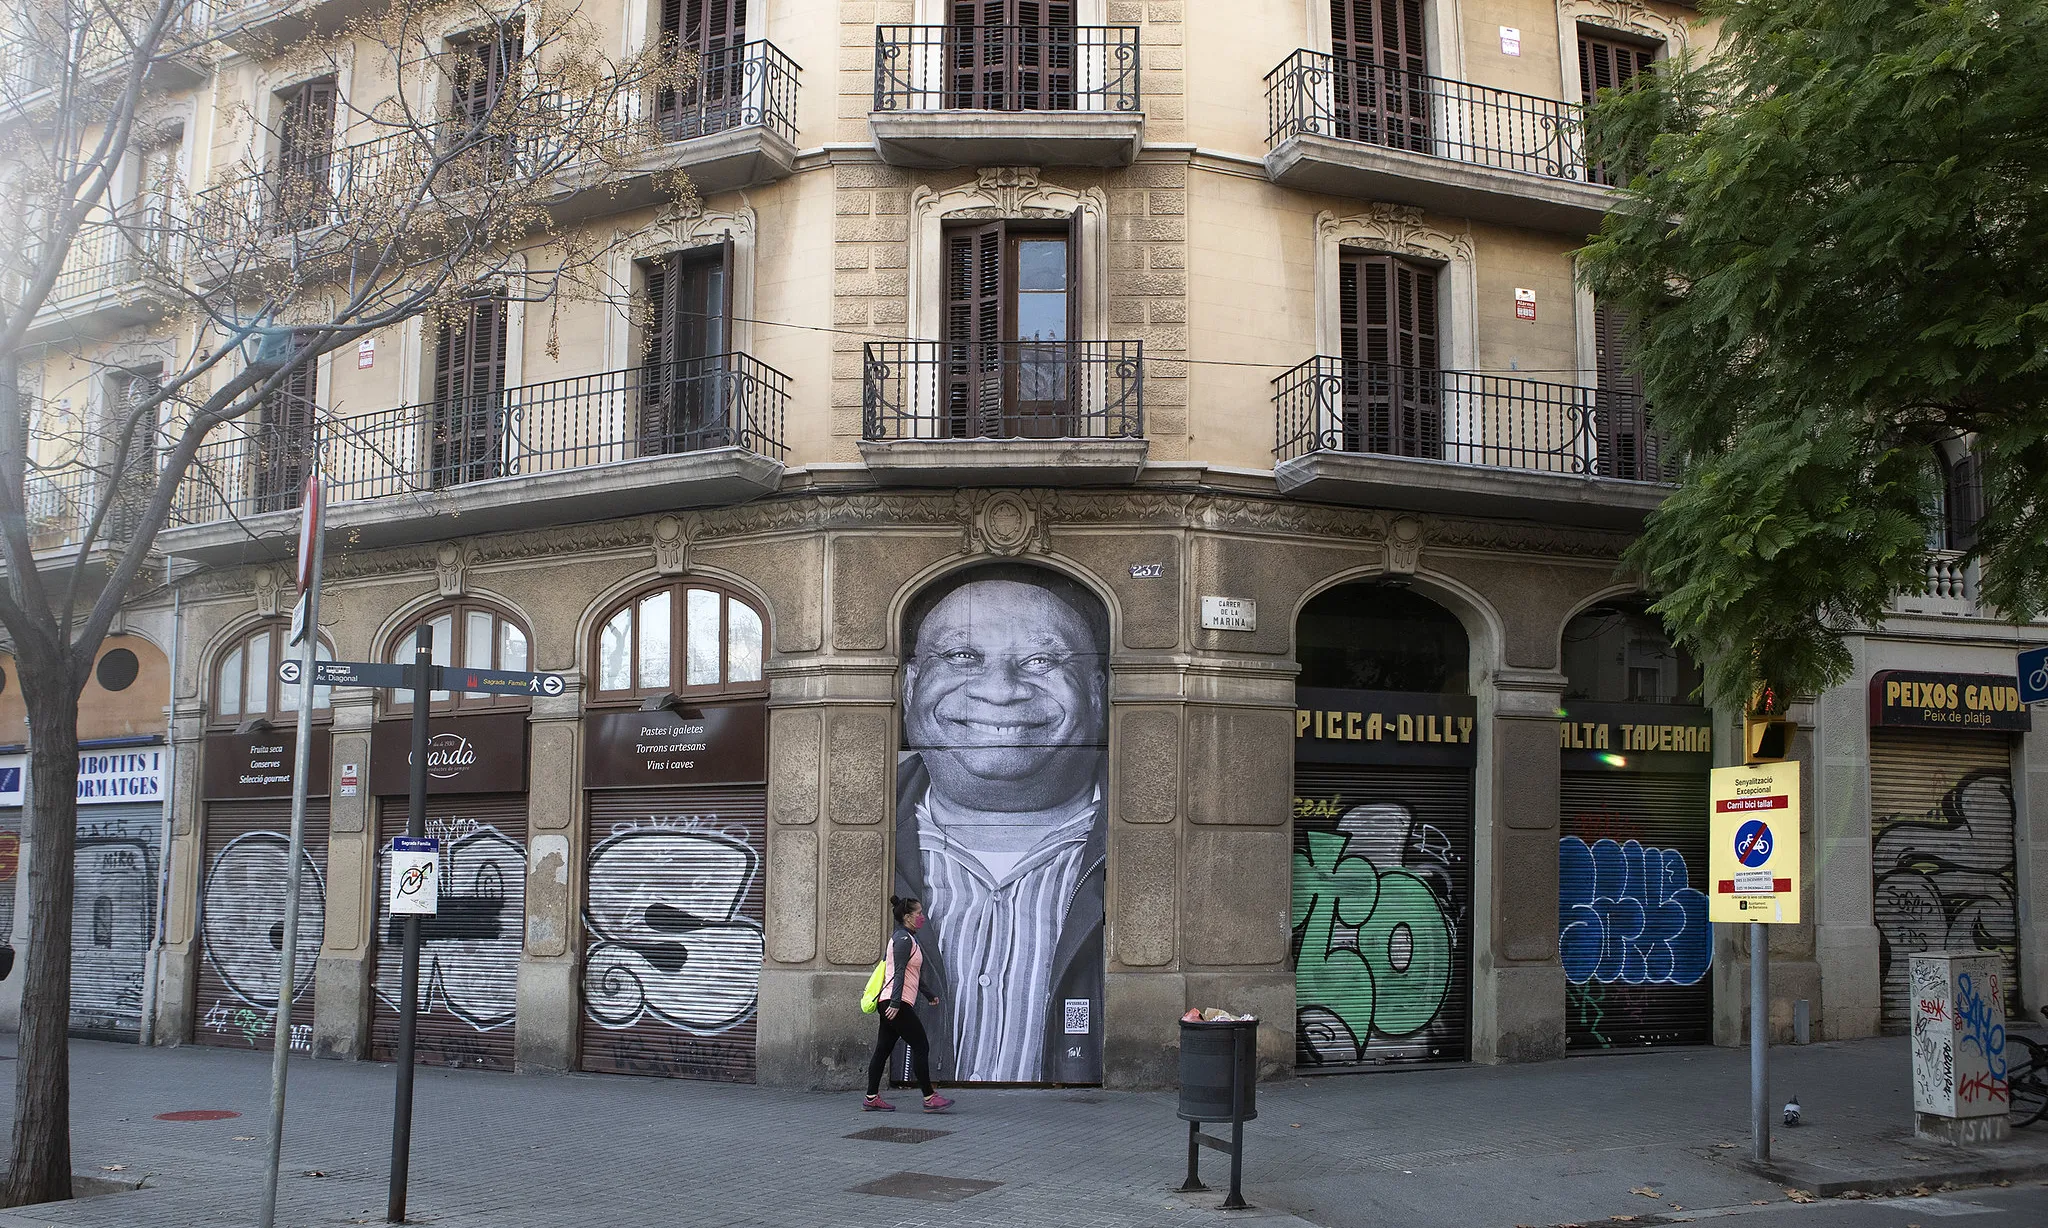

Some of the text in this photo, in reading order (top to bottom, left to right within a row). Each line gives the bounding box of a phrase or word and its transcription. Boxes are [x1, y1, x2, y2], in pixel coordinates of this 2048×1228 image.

[1132, 564, 1161, 576] 237
[1213, 617, 1246, 627] MARINA
[328, 674, 358, 683] Diagonal
[483, 678, 506, 686] Sagrada
[1887, 681, 2026, 712] PEIXOS GAUD
[1924, 709, 1991, 726] Peix de platja
[640, 725, 704, 737] Pastes i galetes
[1296, 709, 1473, 743] PICCA-DILLY
[1620, 724, 1711, 752] TAVERNA
[250, 745, 269, 753] Fruita
[636, 742, 707, 753] Torrons artesans
[152, 752, 160, 770] I
[250, 760, 281, 769] Conserves
[647, 760, 695, 770] Vins i caves
[239, 774, 291, 785] Selecció gourmet
[1735, 776, 1773, 787] Senyalització
[77, 776, 158, 798] ORMATGES
[1736, 786, 1772, 795] Excepcional
[1727, 800, 1773, 810] Carril bici tallat
